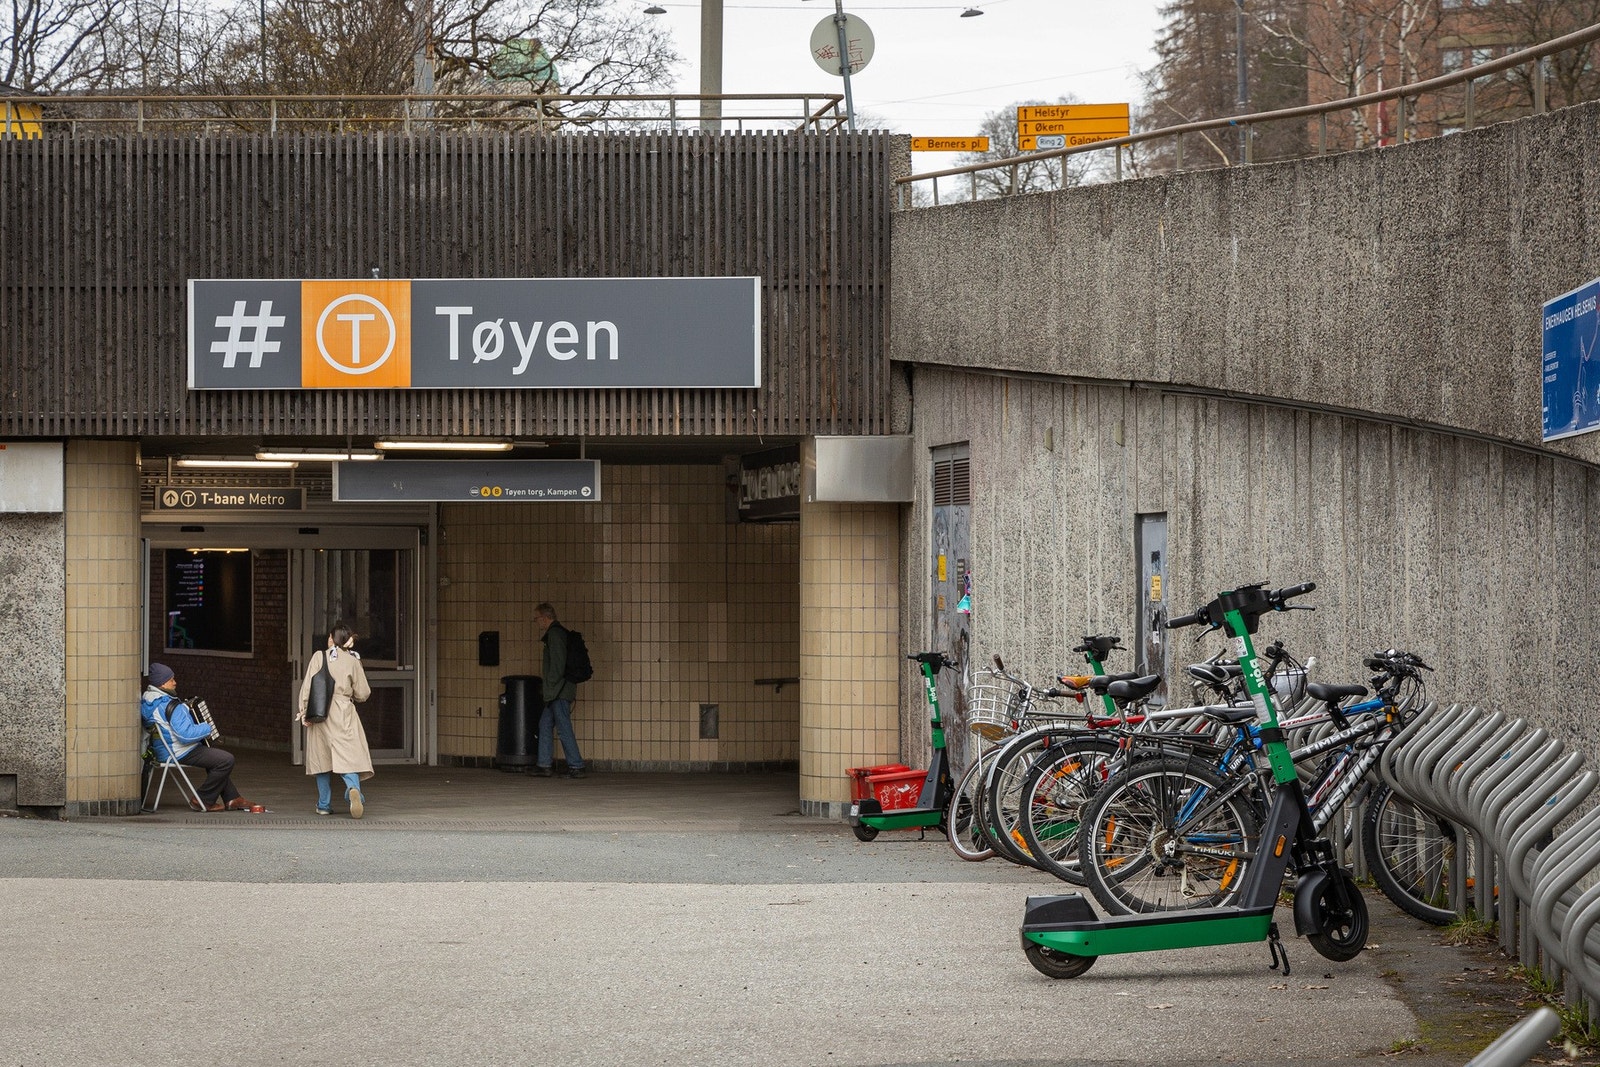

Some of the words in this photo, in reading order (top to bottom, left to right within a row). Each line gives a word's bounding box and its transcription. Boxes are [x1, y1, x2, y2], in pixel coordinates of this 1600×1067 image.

[1034, 107, 1070, 119] Helsfyr
[1035, 122, 1065, 132] Økern
[927, 139, 967, 149] Berners
[971, 139, 983, 150] pl.
[1039, 138, 1056, 147] Ring
[1056, 137, 1063, 146] 2
[435, 306, 619, 375] Tøyen
[505, 488, 526, 497] Tøyen
[547, 488, 578, 497] Kampen
[201, 493, 245, 505] T-bane
[249, 493, 285, 505] Metro
[1249, 658, 1266, 689] Bolt
